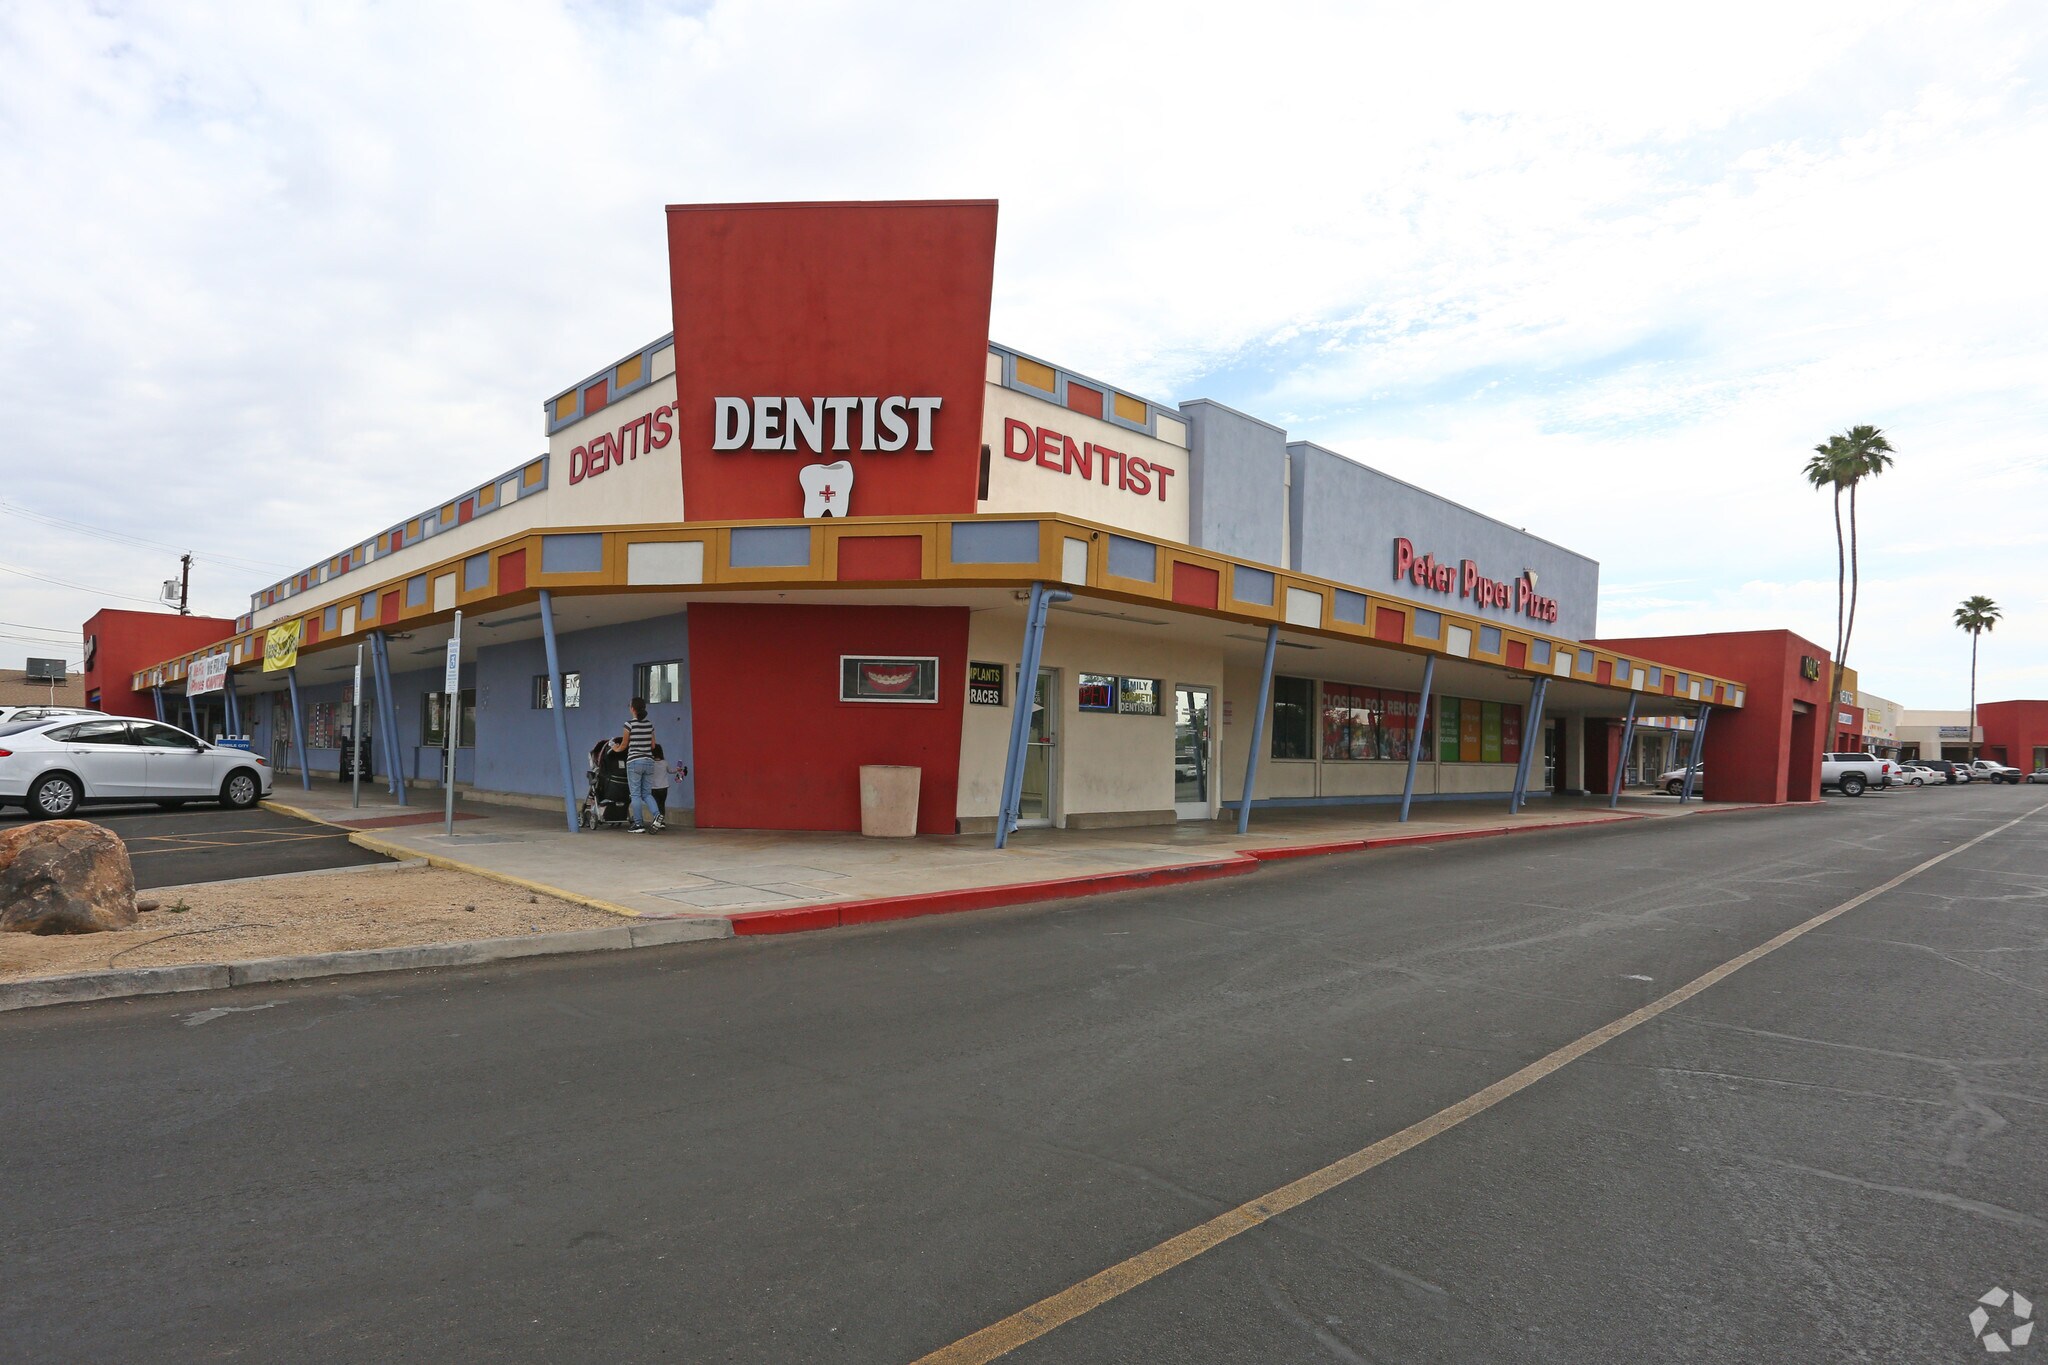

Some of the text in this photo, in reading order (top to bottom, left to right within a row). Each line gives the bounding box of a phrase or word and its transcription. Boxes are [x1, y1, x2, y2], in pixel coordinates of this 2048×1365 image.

[712, 396, 942, 453] DENTIST
[569, 400, 679, 485] DENTIS
[1004, 417, 1175, 501] DENTIST
[1393, 537, 1558, 623] Peter Piper Pizza
[1121, 679, 1149, 691] FAMILY
[970, 688, 999, 704] RACES
[1121, 691, 1157, 703] COSMETIC
[1321, 692, 1362, 709] CLOSED
[1121, 702, 1157, 713] DENTISTRY
